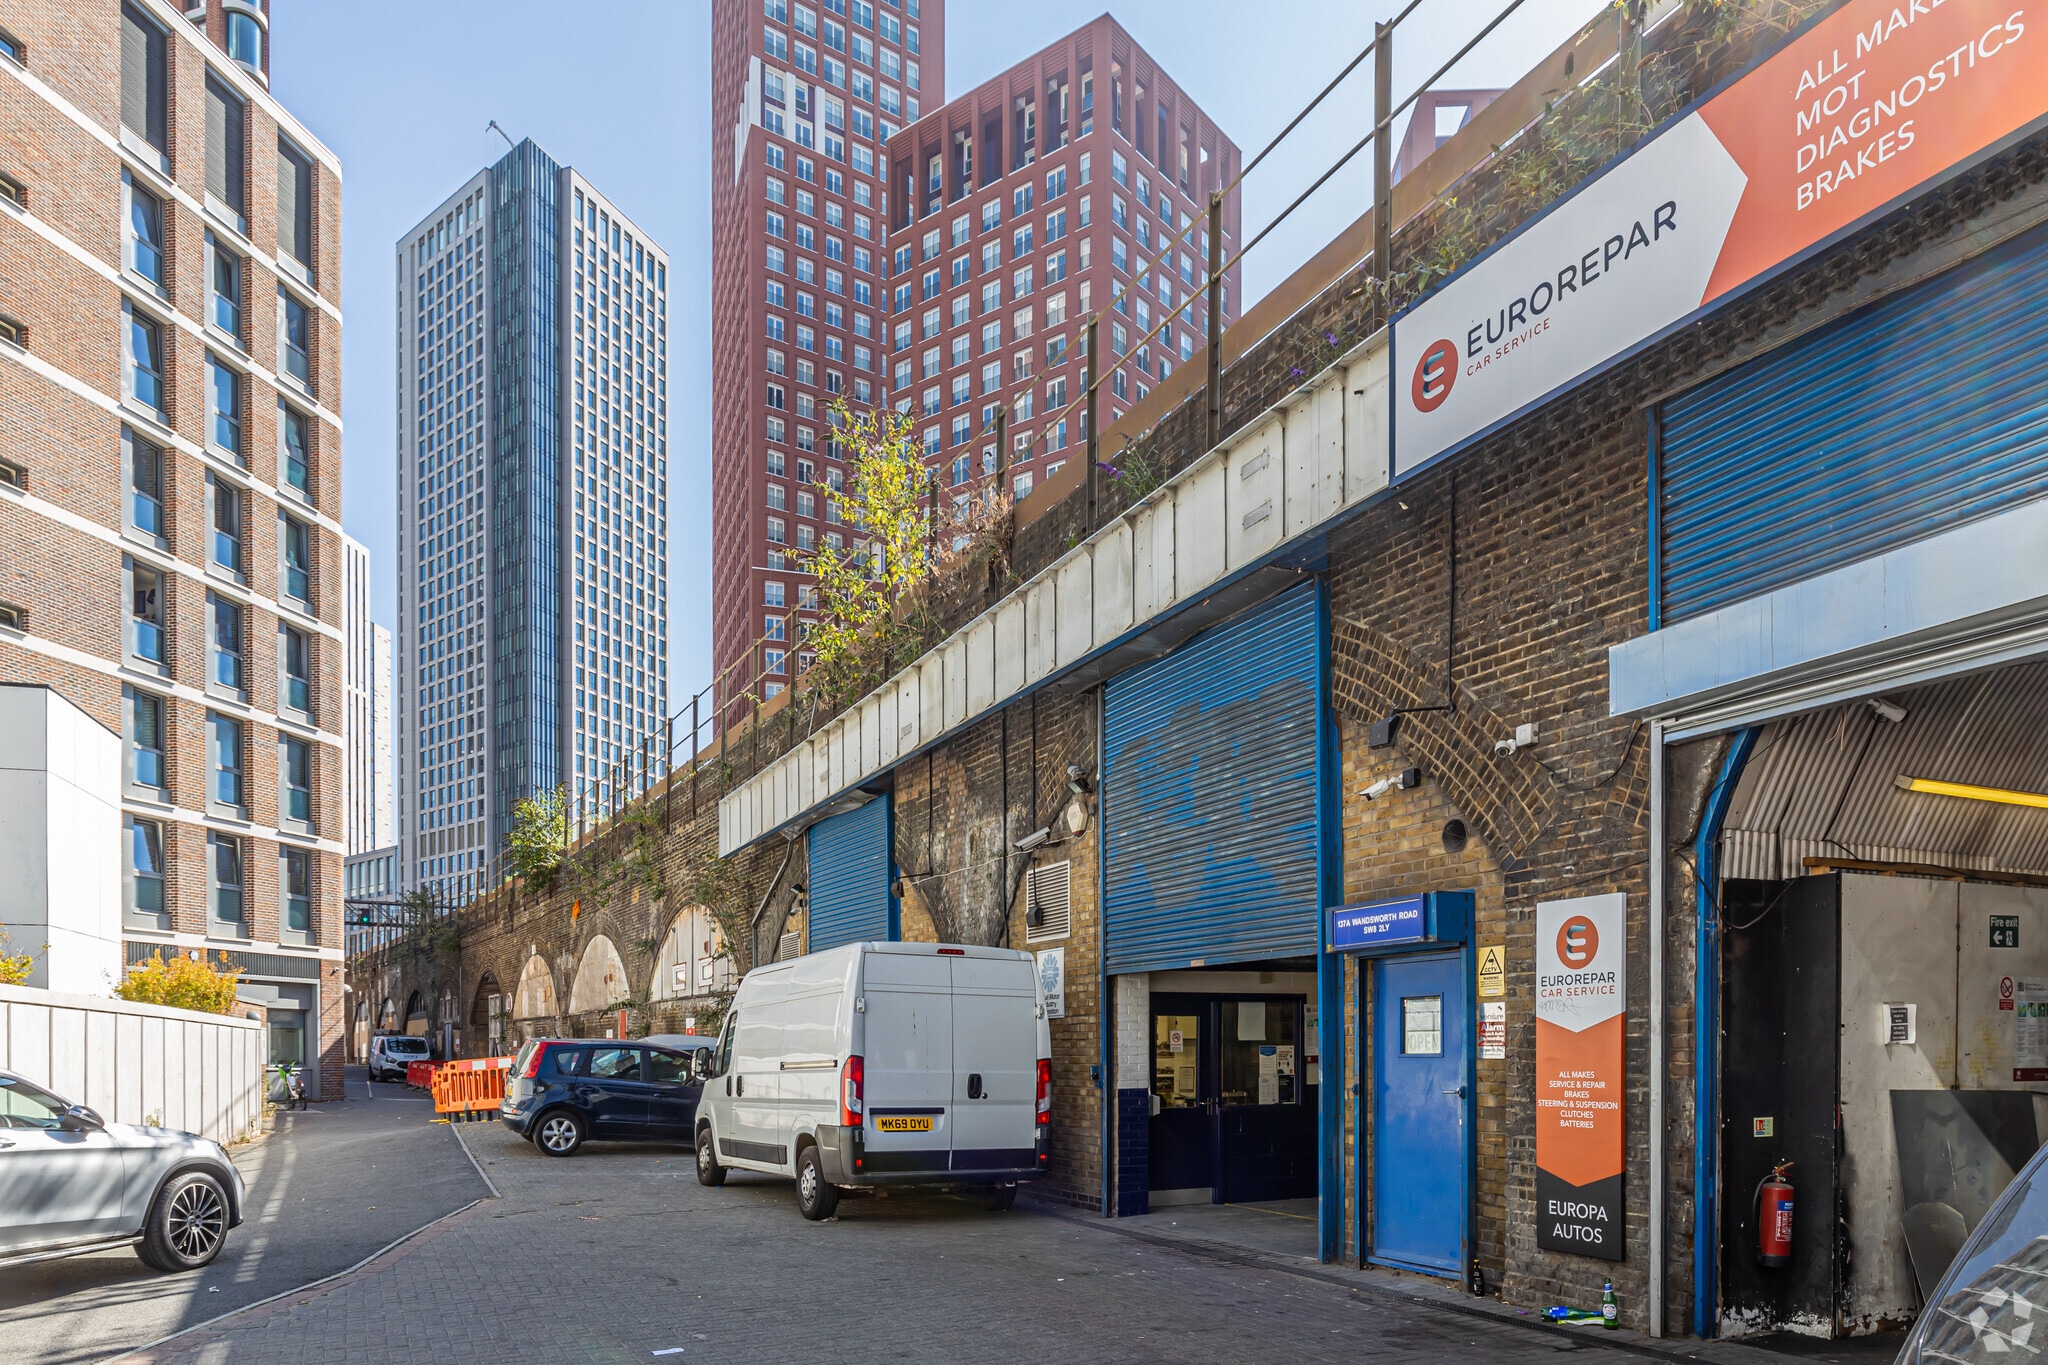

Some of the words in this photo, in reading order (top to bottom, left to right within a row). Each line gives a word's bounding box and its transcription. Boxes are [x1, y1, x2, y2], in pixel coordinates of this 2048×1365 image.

[1795, 49, 1848, 100] ALL
[1796, 10, 2025, 174] DIAGNOSTICS
[1796, 69, 1866, 136] MOT
[1796, 119, 1916, 211] BRAKES
[1467, 200, 1677, 358] EUROREPAR
[1467, 354, 1492, 377] CAR
[1495, 317, 1551, 360] SERVICE
[1338, 919, 1351, 928] 137A
[1352, 912, 1397, 926] WANDSWORTH
[1398, 909, 1418, 920] ROAD
[1990, 916, 2004, 927] Fire
[2005, 917, 2018, 928] exit
[1363, 925, 1377, 934] SW8
[1378, 923, 1390, 933] 2LY
[1541, 971, 1616, 988] EUROREPAR
[1541, 988, 1563, 998] CAR
[1566, 984, 1616, 997] SERVICE
[1481, 1022, 1504, 1032] Alarm
[1409, 1033, 1440, 1052] OPEN
[1559, 1071, 1571, 1079] ALL
[1572, 1071, 1595, 1079] MAKES
[1549, 1080, 1575, 1089] SERVICE
[1576, 1081, 1581, 1089] &
[1583, 1081, 1606, 1089] REPAIR
[1564, 1090, 1590, 1099] BRAKES
[1538, 1099, 1568, 1108] STEERING
[1569, 1100, 1574, 1108] &
[1576, 1100, 1618, 1110] SUSPENSION
[1560, 1110, 1594, 1119] CLUTCHES
[881, 1118, 908, 1129] MK69
[910, 1118, 929, 1129] OYU
[1560, 1119, 1594, 1129] BATTERIES
[1548, 1200, 1608, 1222] EUROPA
[1552, 1222, 1603, 1244] AUTOS
